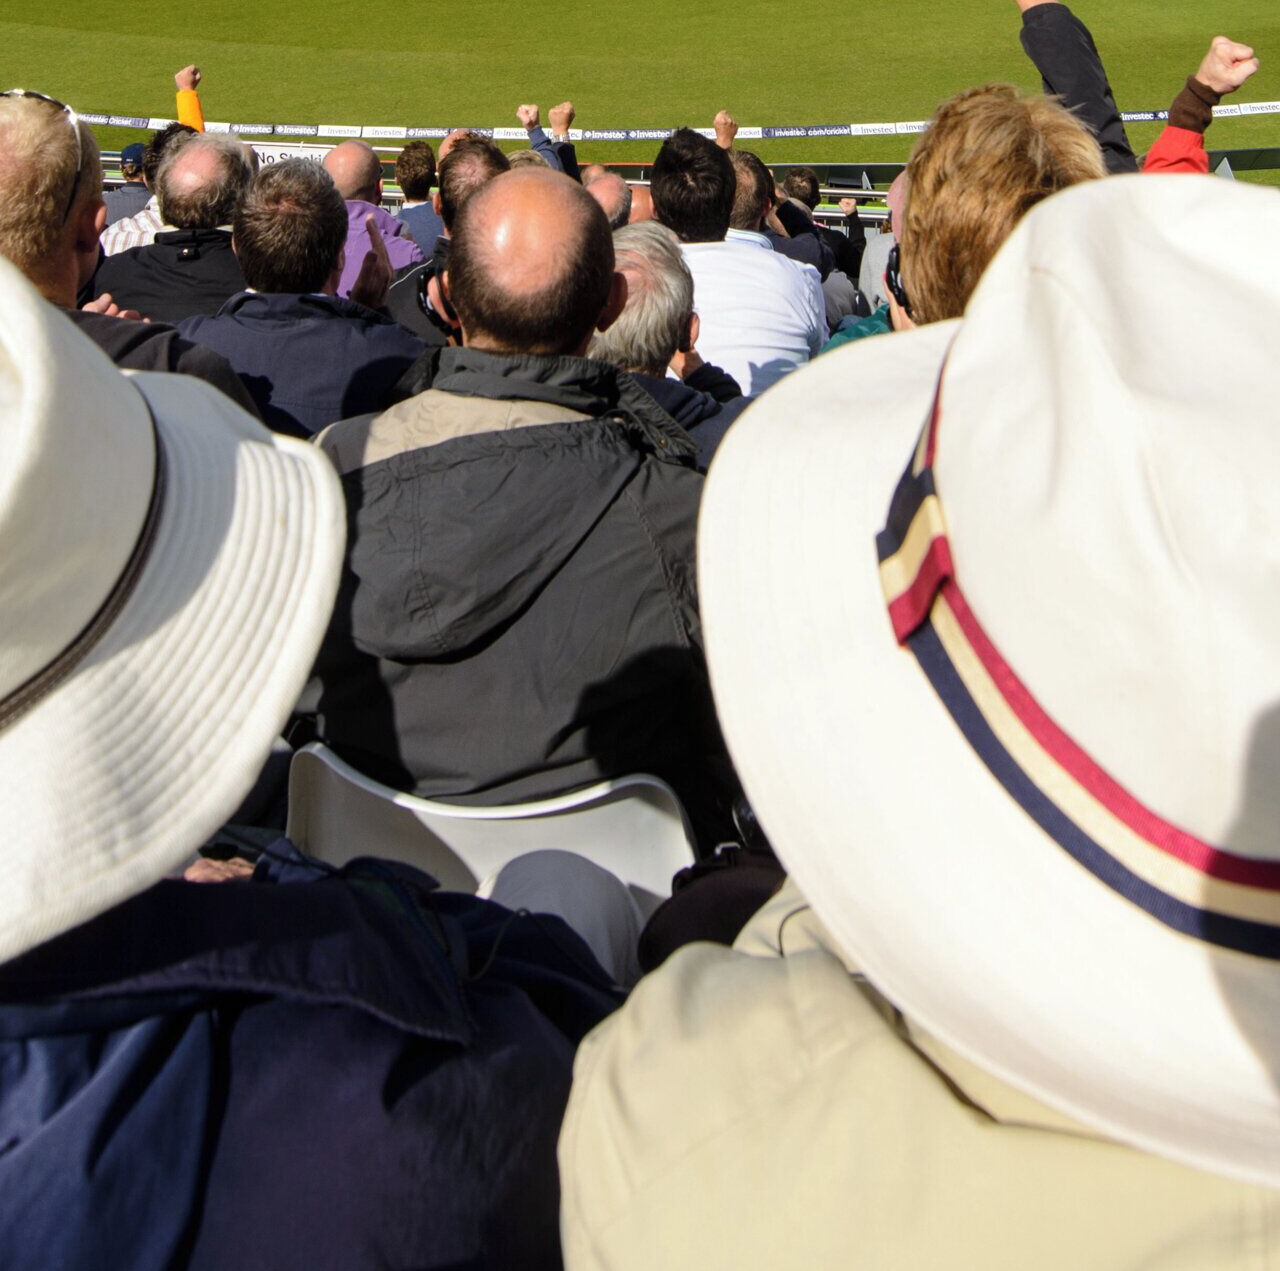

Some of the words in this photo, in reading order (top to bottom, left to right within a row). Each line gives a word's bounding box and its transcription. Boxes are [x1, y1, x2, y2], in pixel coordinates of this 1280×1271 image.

[1249, 103, 1280, 113] Investec
[1122, 112, 1154, 121] Investec
[239, 125, 272, 134] Investec
[284, 126, 316, 135] Investec
[327, 127, 359, 136] Investec
[371, 129, 404, 137] Investec
[415, 129, 448, 137] Investec
[591, 130, 625, 138] Investec
[637, 130, 671, 138] Investec
[861, 125, 893, 134] Investec
